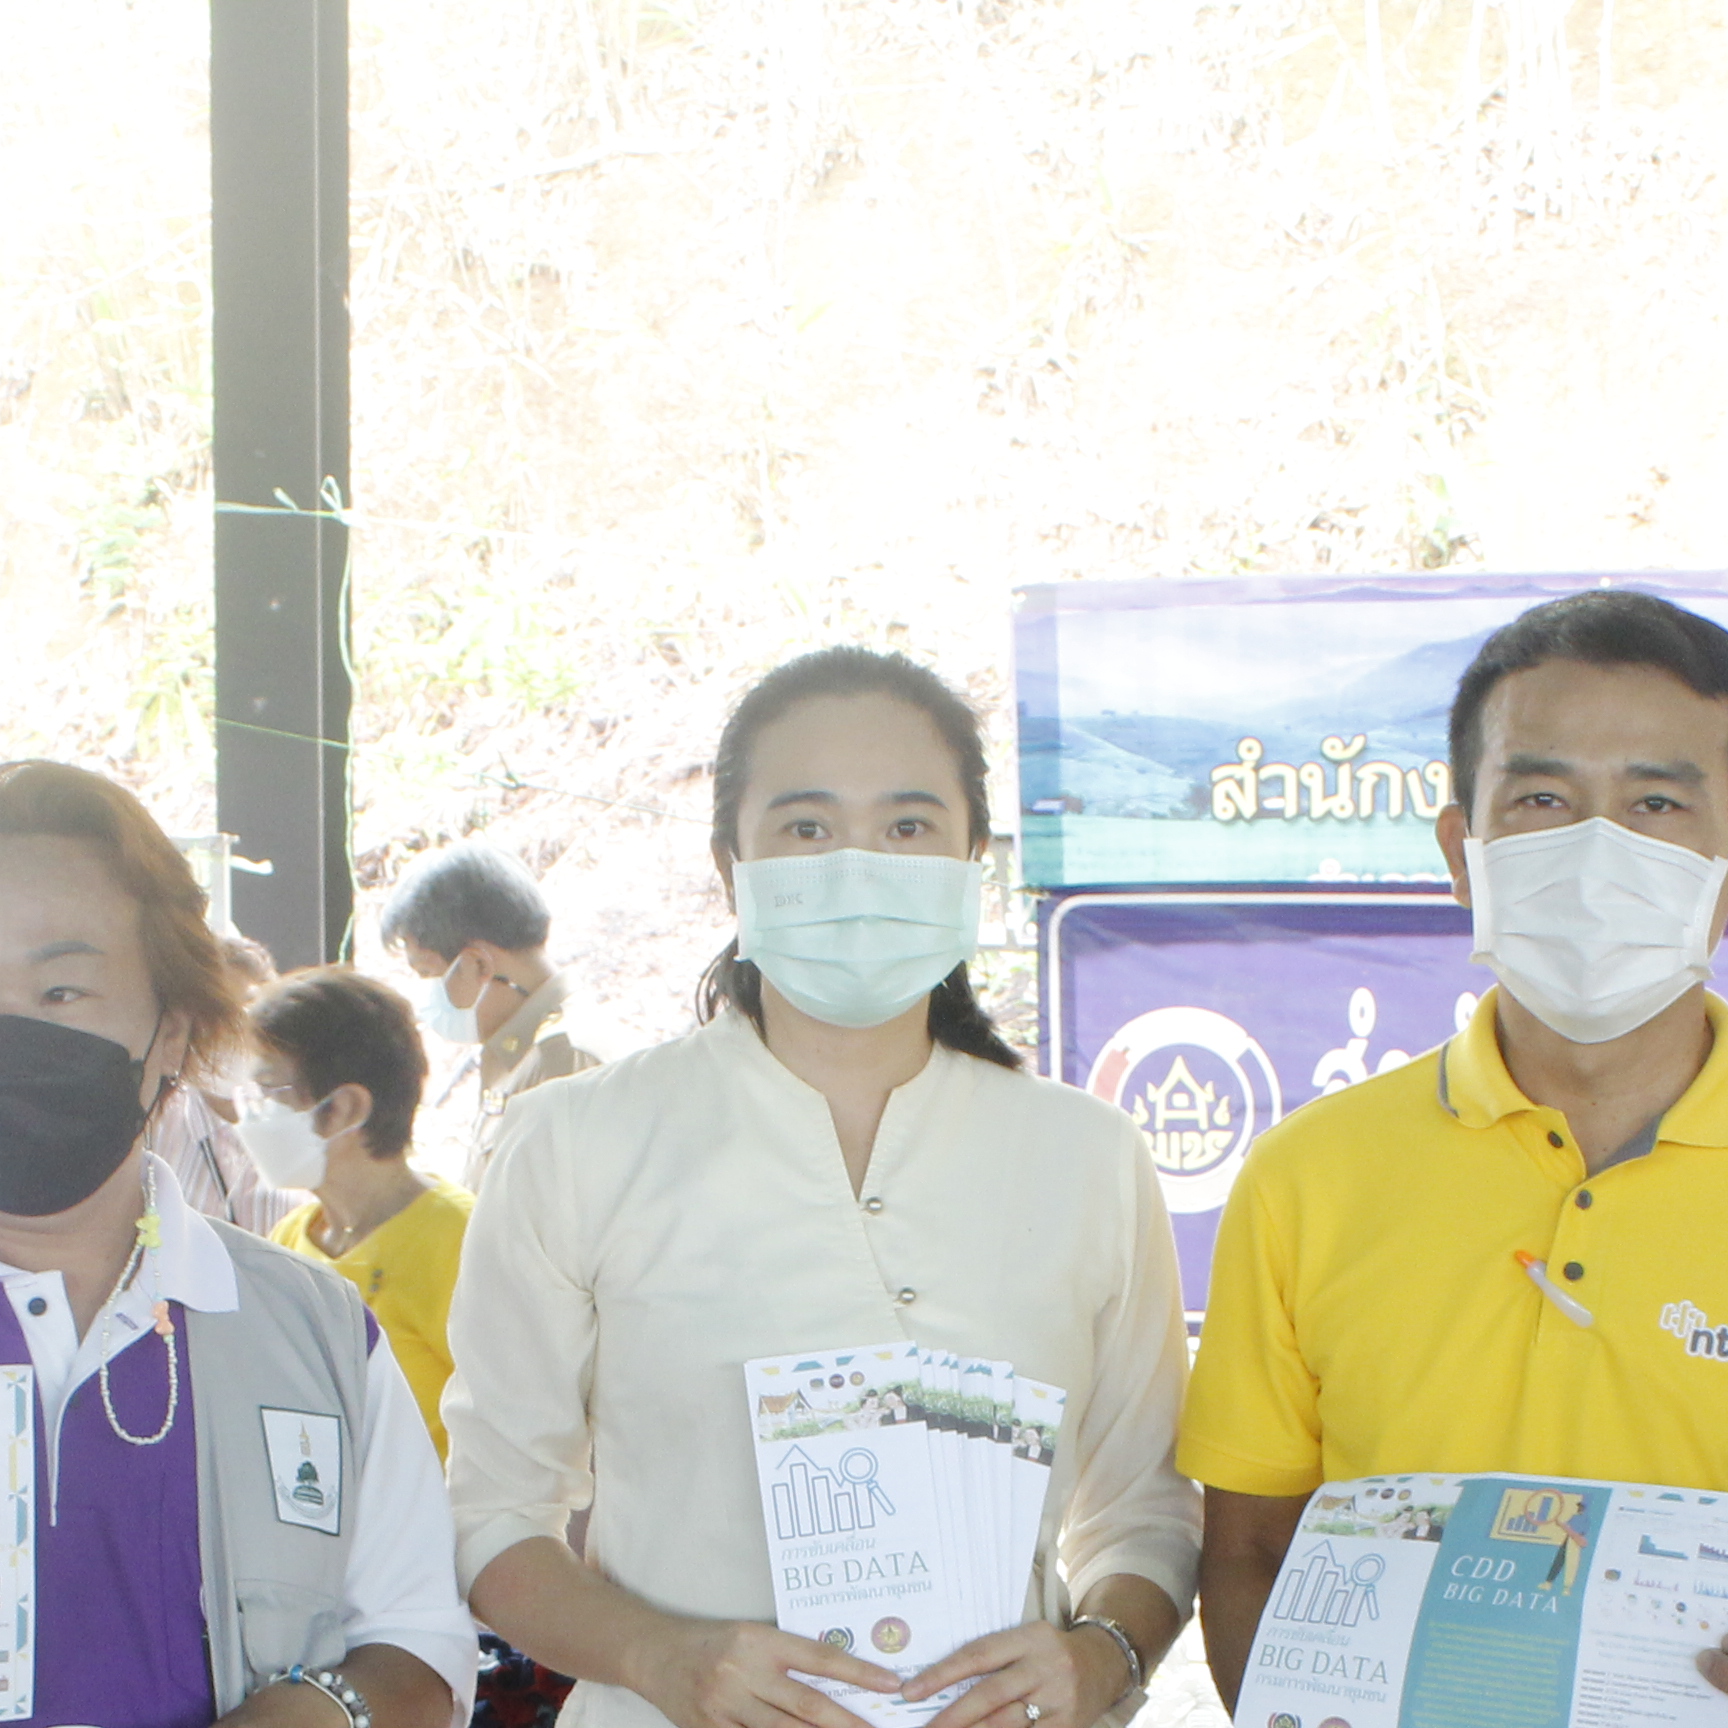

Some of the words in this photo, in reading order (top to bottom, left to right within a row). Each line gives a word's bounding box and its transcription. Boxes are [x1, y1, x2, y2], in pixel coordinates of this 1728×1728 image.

[782, 1562, 834, 1592] BIG
[843, 1550, 930, 1583] DATA
[1450, 1555, 1517, 1583] CDD
[1443, 1582, 1484, 1604] BIG
[1491, 1588, 1559, 1614] DATA
[1258, 1643, 1304, 1672] BIG
[1311, 1651, 1389, 1685] DATA
